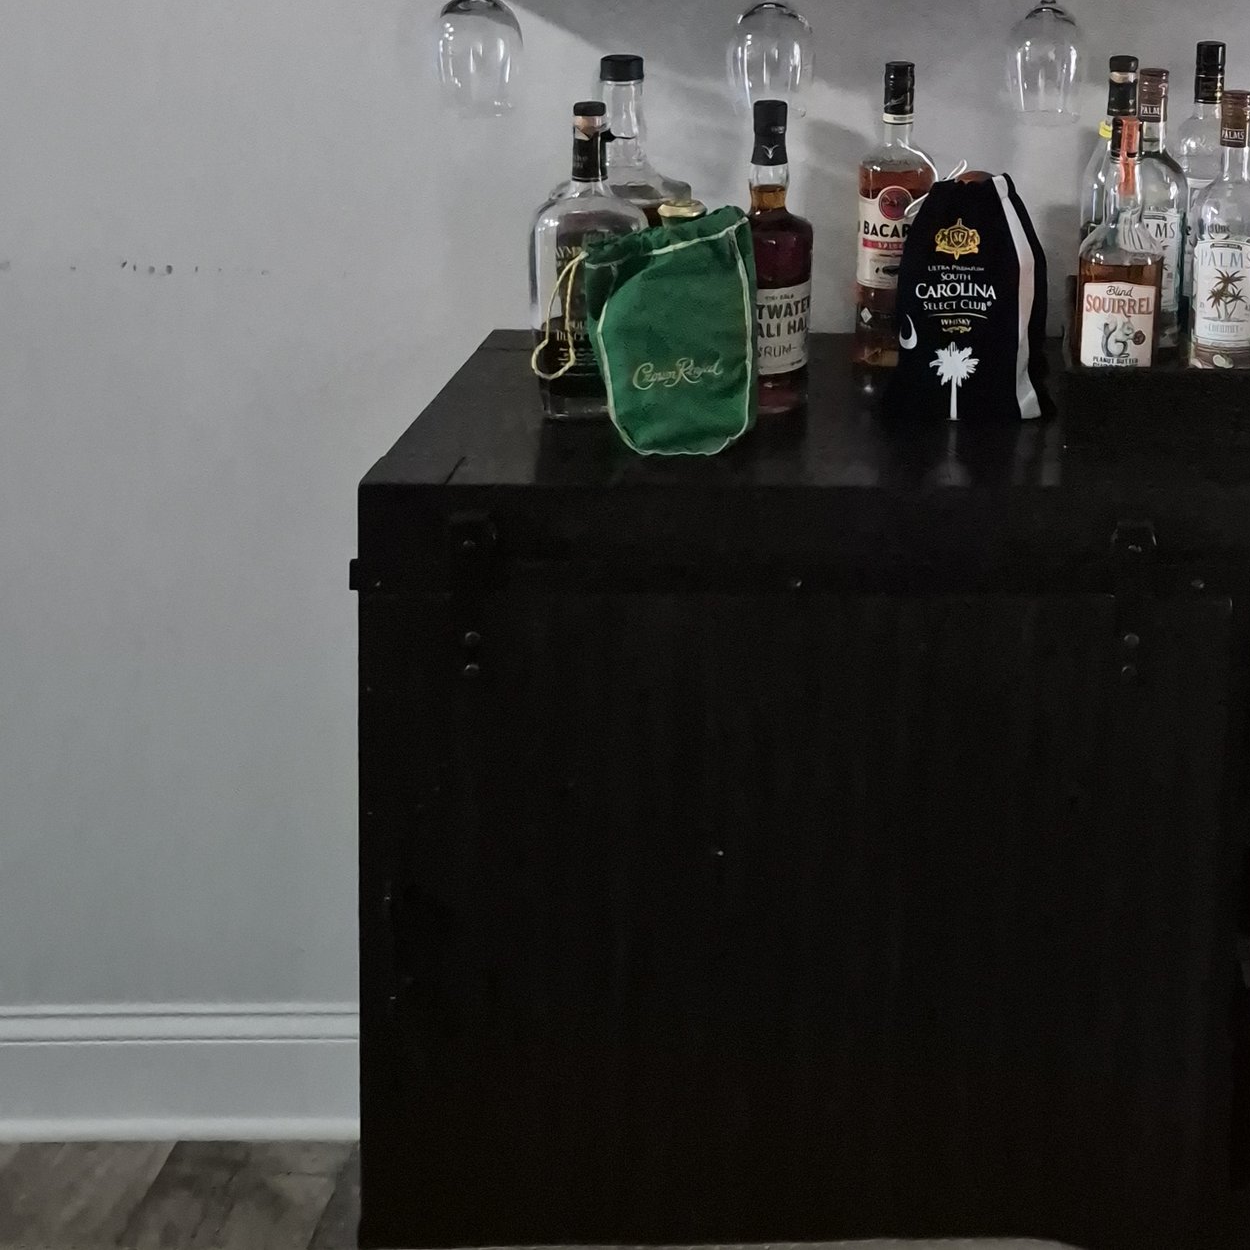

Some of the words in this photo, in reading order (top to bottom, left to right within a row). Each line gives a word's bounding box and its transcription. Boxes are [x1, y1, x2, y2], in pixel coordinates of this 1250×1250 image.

[1221, 130, 1245, 141] PALMS
[940, 271, 972, 282] SOUTH
[915, 282, 997, 300] CAROLINA
[1106, 285, 1134, 298] Blind
[923, 300, 957, 311] SELECT
[1085, 293, 1153, 318] SQUIRREL
